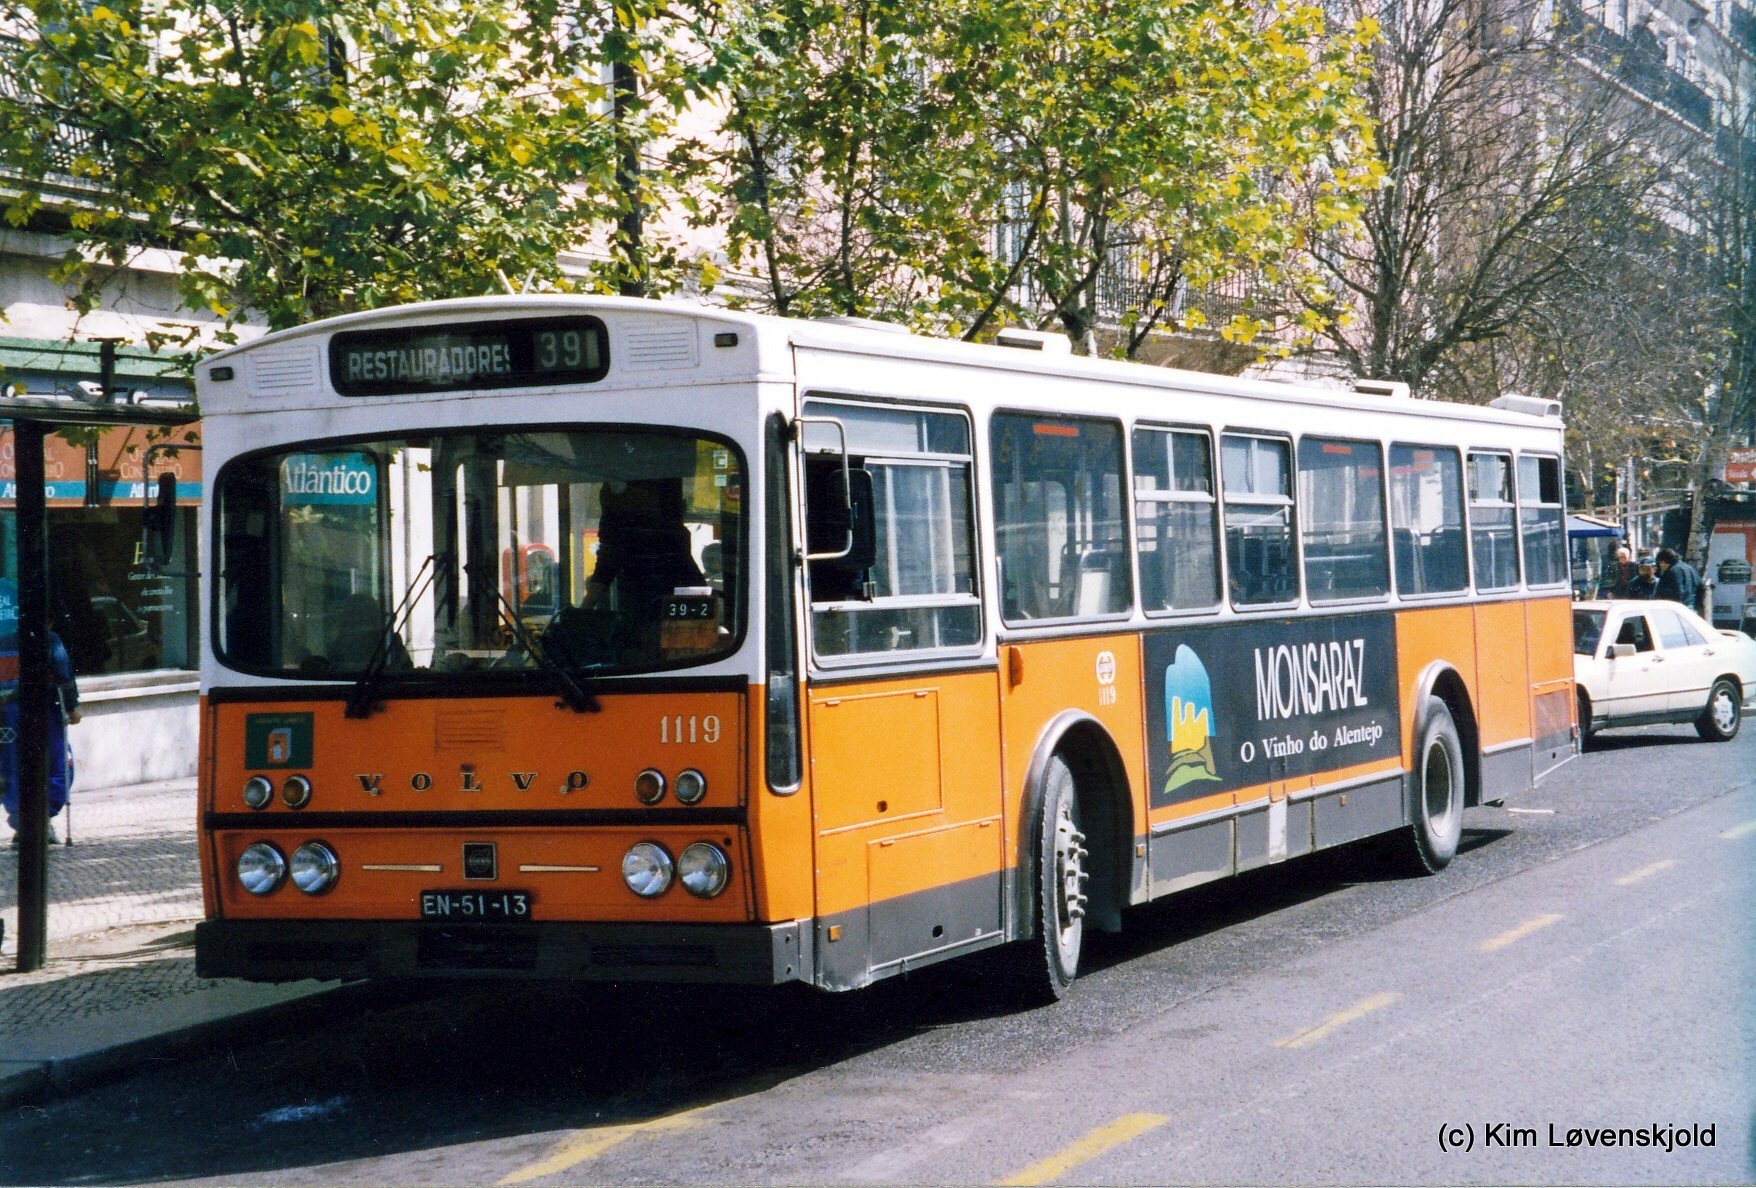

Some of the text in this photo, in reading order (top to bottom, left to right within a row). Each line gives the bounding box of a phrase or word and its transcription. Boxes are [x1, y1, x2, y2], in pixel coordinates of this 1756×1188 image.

[541, 331, 581, 368] 39
[1254, 638, 1368, 721] MONSARAZ
[1098, 685, 1116, 706] 1119
[660, 715, 720, 744] 1119
[1262, 732, 1303, 759] Vinho
[1309, 729, 1328, 751] do
[1333, 720, 1383, 748] Alentejo
[356, 770, 590, 794] VOLVO
[422, 893, 528, 917] EN-51-13
